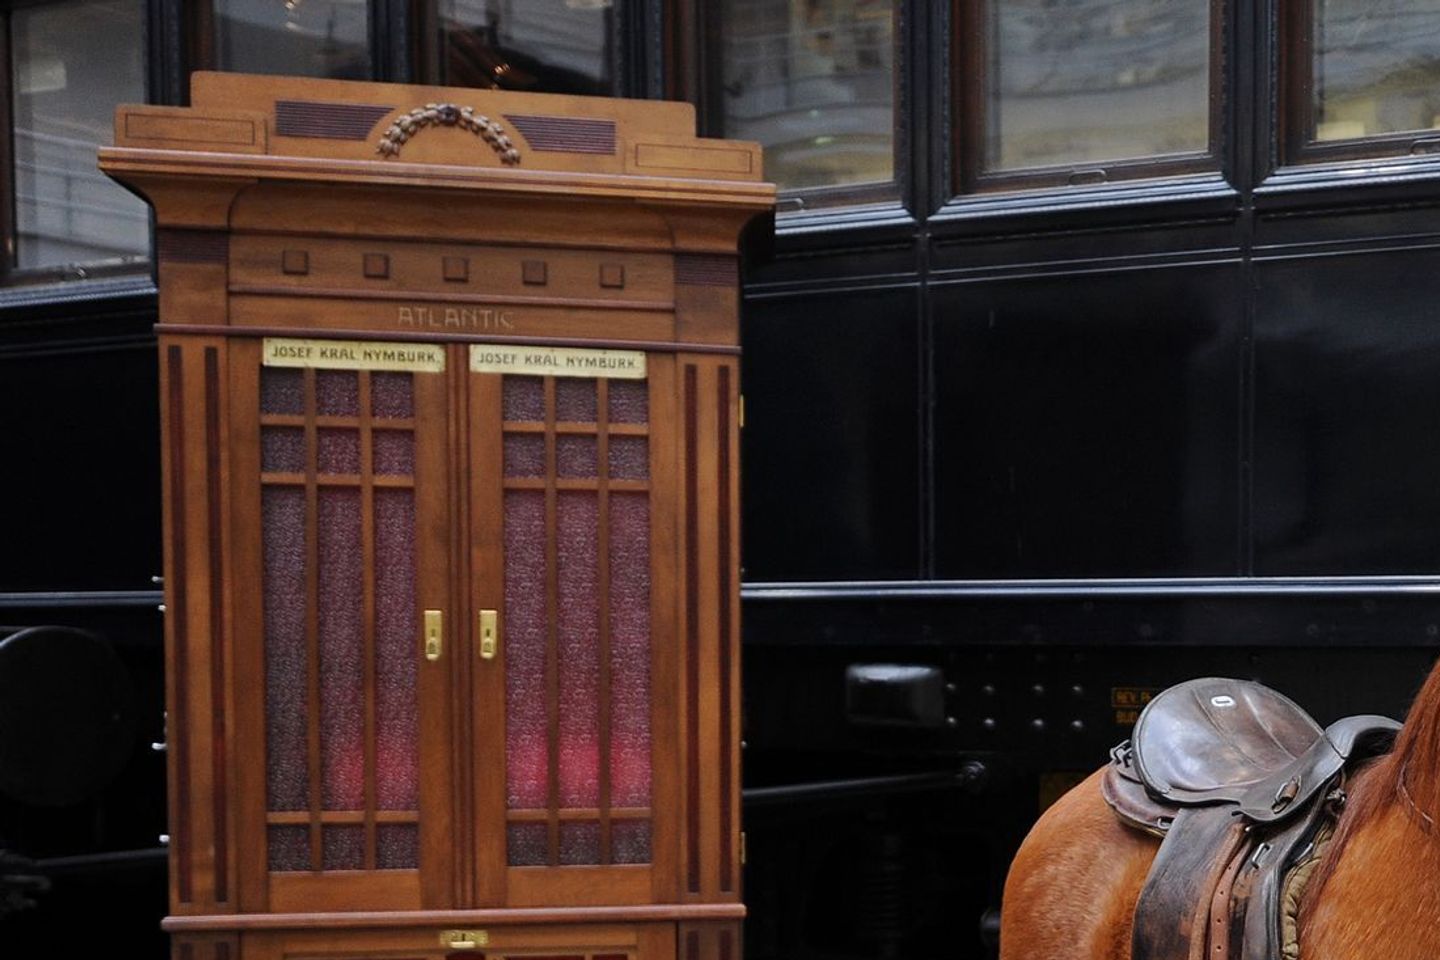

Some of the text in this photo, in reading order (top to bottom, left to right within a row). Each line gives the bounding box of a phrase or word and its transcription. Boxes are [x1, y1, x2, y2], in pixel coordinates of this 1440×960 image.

[398, 306, 515, 330] ATLANTIC
[272, 346, 314, 359] JOSEF
[478, 352, 518, 365] JOSEF
